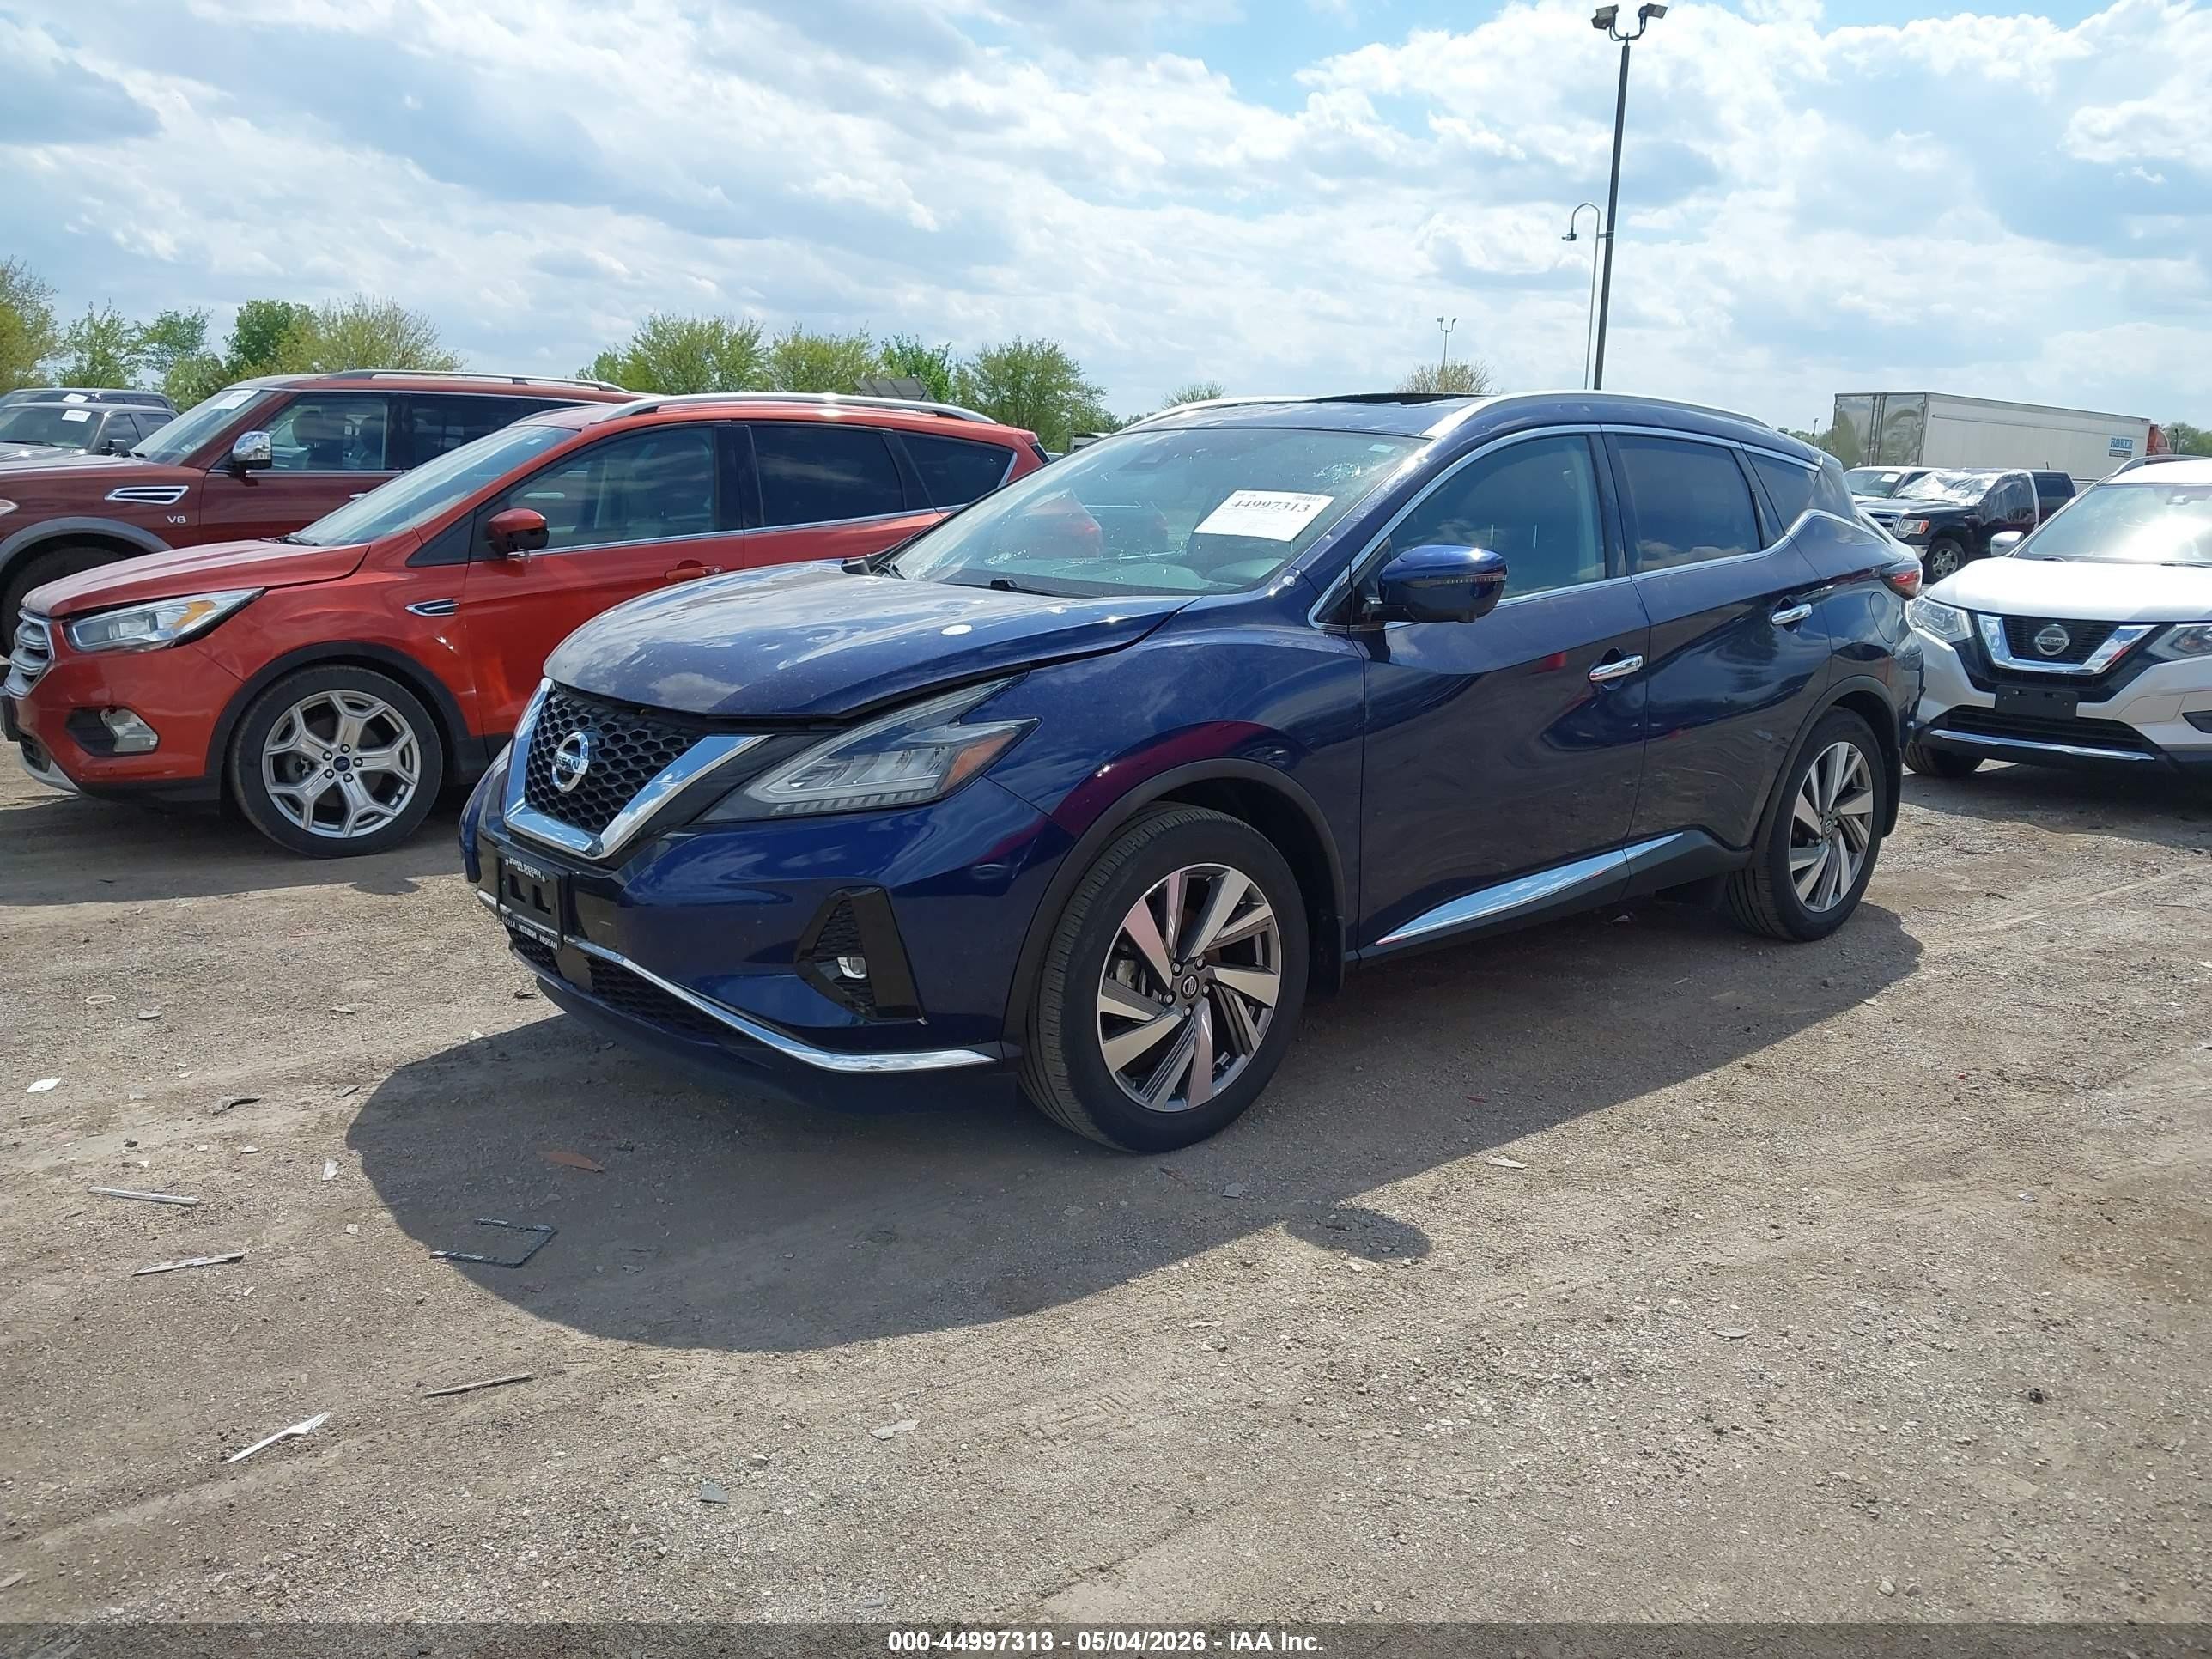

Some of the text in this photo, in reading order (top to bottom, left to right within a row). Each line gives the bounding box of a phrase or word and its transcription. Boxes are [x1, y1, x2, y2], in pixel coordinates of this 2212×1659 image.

[1232, 500, 1311, 514] 44997313
[166, 515, 186, 524] V8
[2037, 637, 2066, 646] NISSAN
